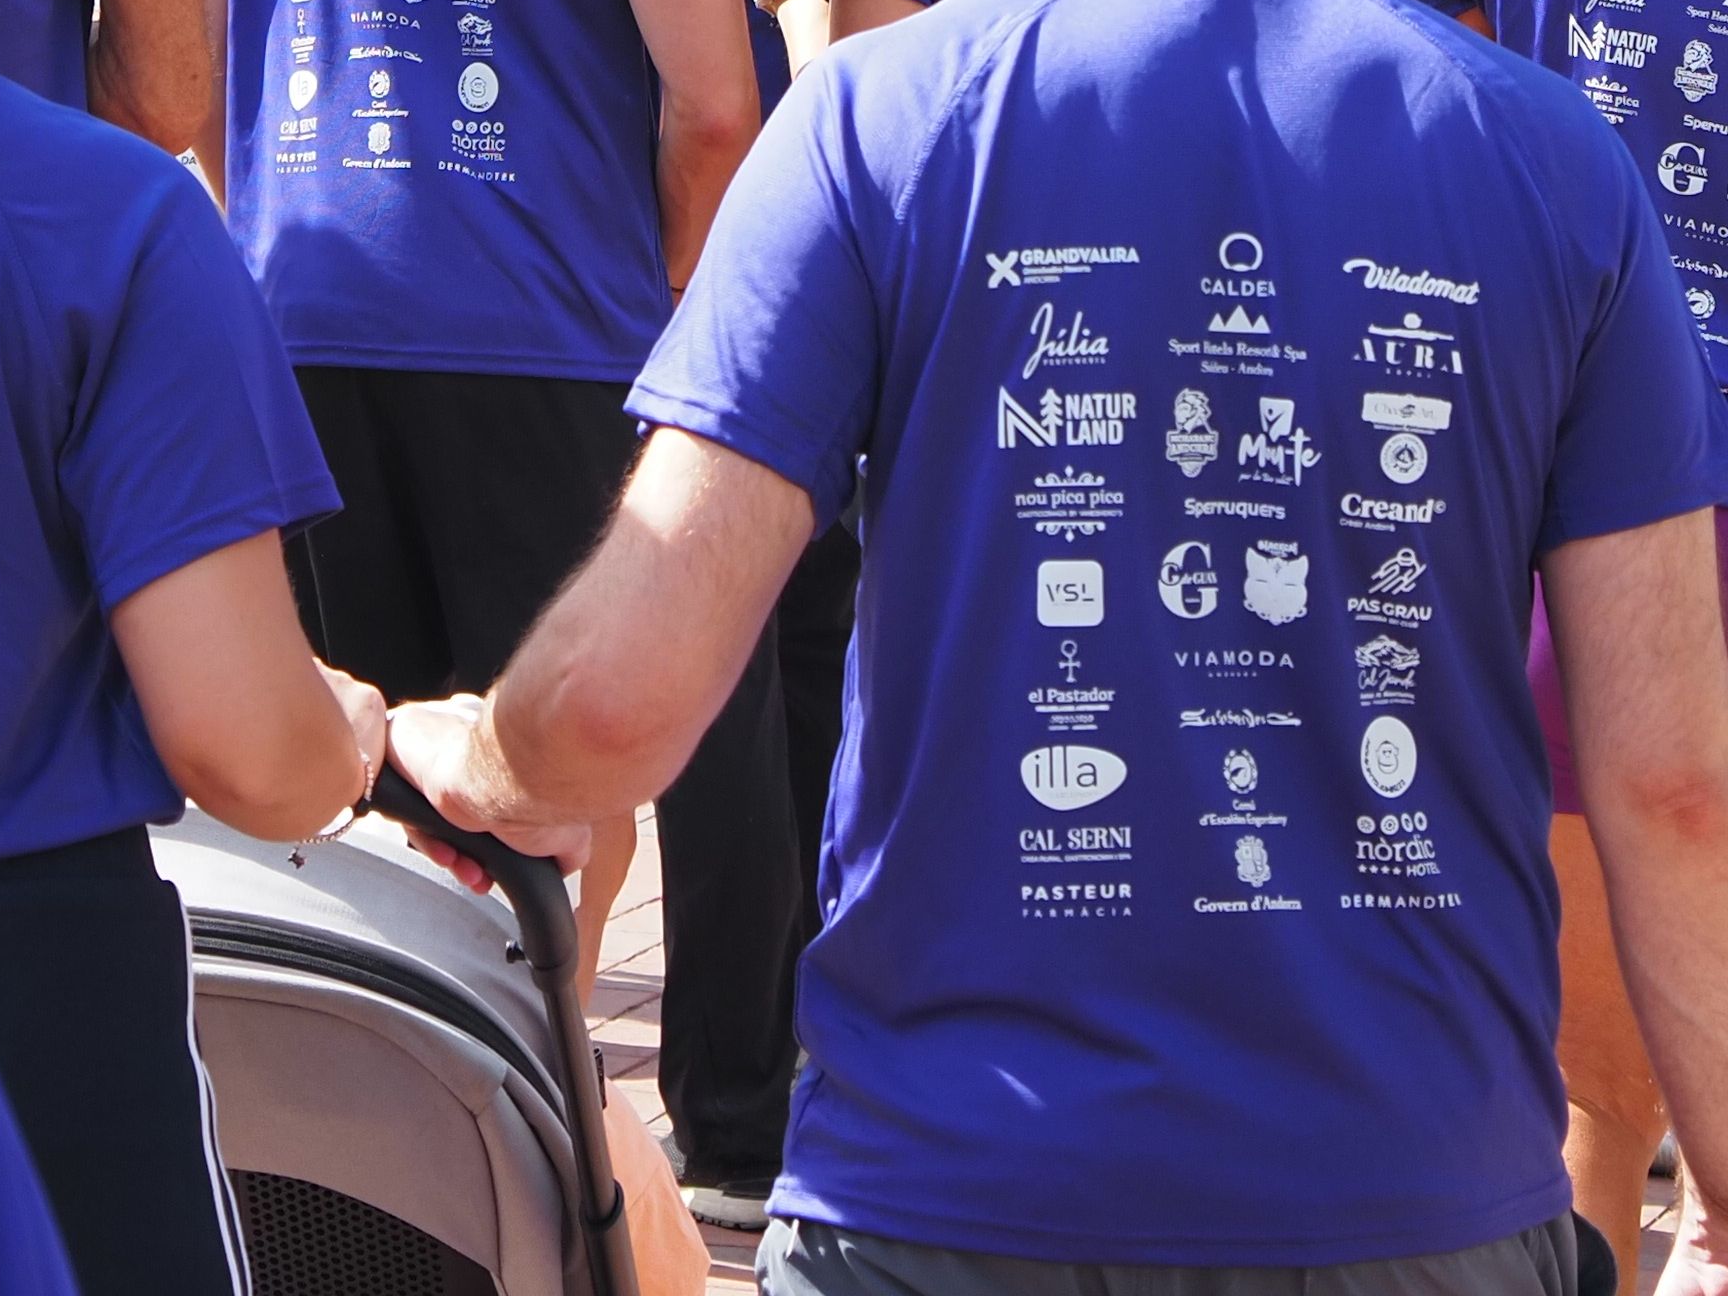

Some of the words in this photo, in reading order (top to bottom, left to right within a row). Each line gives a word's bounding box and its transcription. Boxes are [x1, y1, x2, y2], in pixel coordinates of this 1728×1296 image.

[1686, 5, 1710, 20] Sport
[1608, 27, 1658, 55] NATUR
[1604, 46, 1646, 69] LAND
[1616, 95, 1641, 108] pica
[451, 132, 506, 152] nòrdic
[478, 152, 504, 161] HOTEL
[1021, 247, 1140, 265] GRANDVALIRA
[1342, 257, 1480, 305] Viladomat
[1022, 303, 1109, 380] Júlia
[1168, 339, 1200, 358] Sport
[1284, 345, 1307, 362] Spa
[1353, 338, 1463, 375] AURA
[1065, 393, 1137, 420] NATUR
[1066, 420, 1124, 446] LAND
[1015, 493, 1047, 507] nou
[1051, 490, 1085, 508] pica
[1089, 490, 1124, 508] pica
[1184, 498, 1285, 520] Sperruquers
[1046, 584, 1095, 602] VSL
[1348, 598, 1380, 613] PAS
[1383, 600, 1432, 621] GRAU
[1174, 651, 1294, 668] VIAMODA
[1028, 690, 1043, 703] el
[1047, 688, 1115, 703] Pastador
[1033, 747, 1098, 788] illa
[1020, 829, 1062, 851] CAL
[1068, 827, 1131, 850] SERNI
[1021, 885, 1132, 901] PASTEUR
[1194, 897, 1249, 913] Govern
